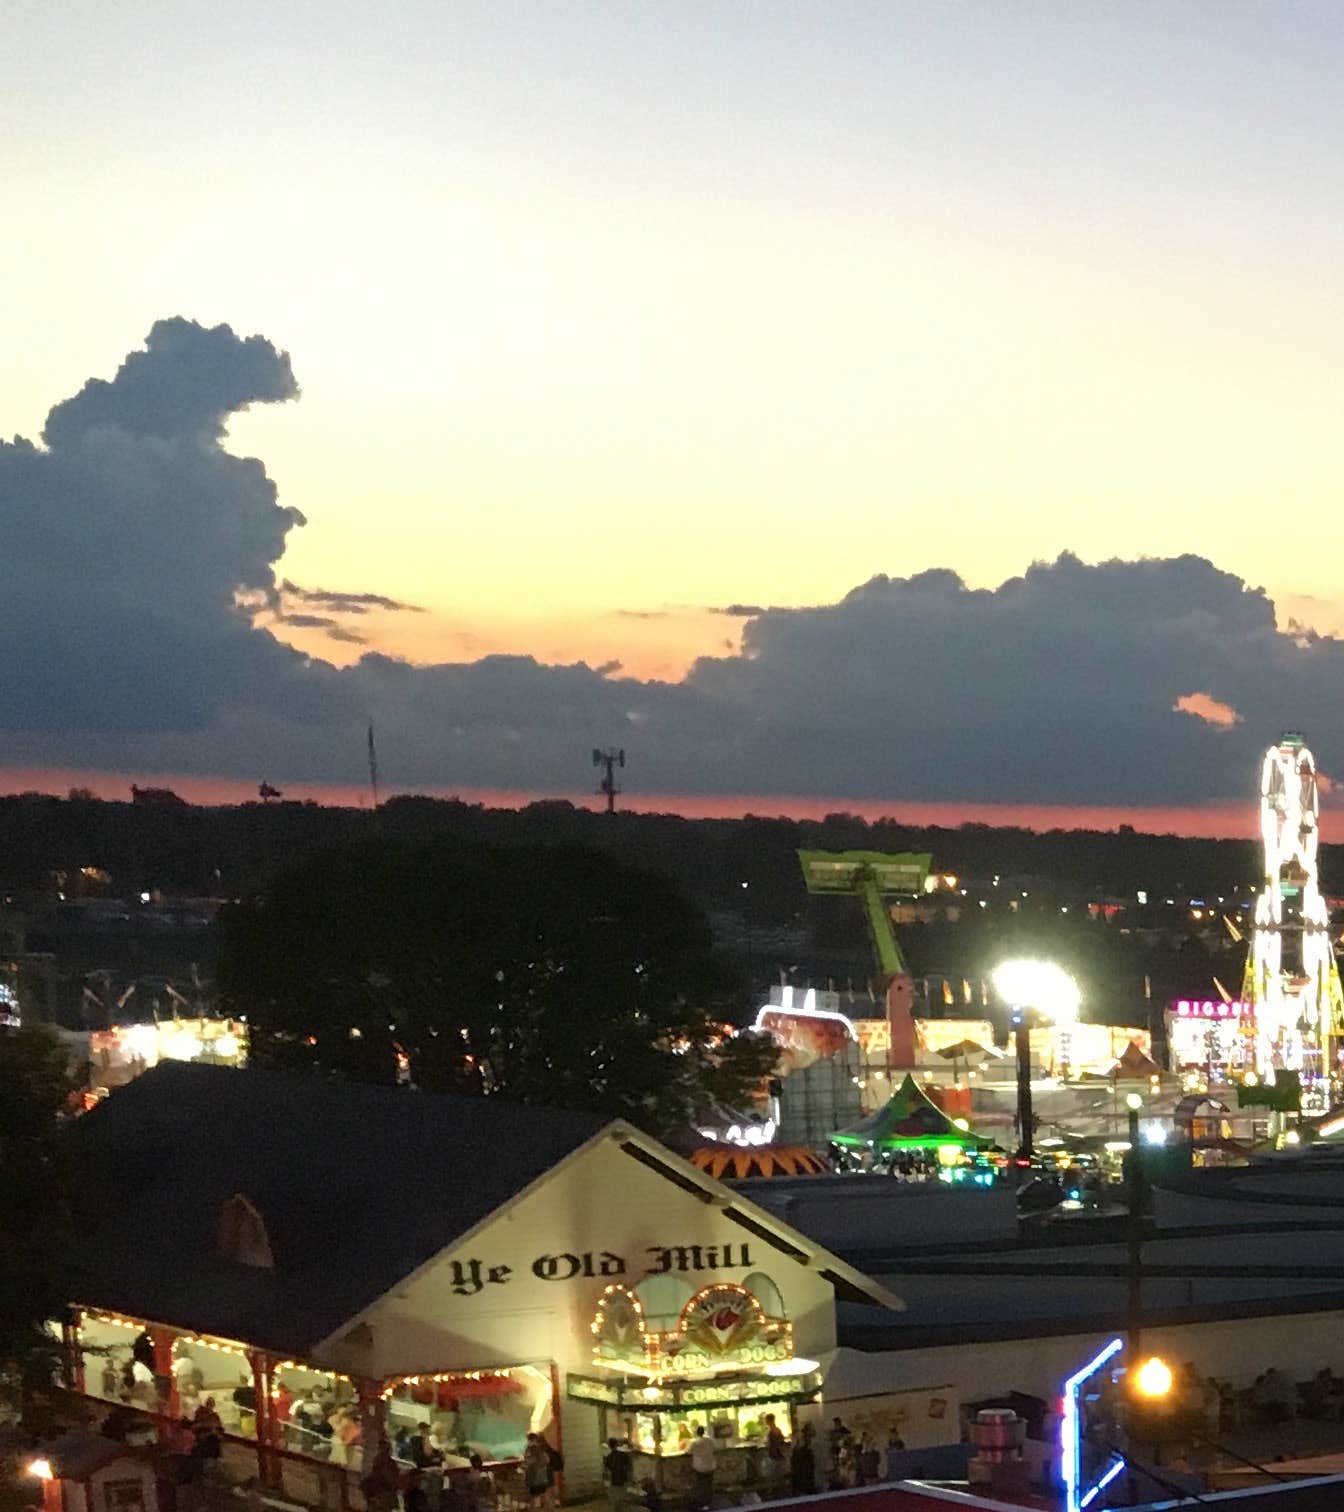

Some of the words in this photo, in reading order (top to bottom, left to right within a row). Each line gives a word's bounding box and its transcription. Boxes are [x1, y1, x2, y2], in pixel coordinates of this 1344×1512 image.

[450, 1258, 512, 1295] Ye
[532, 1252, 626, 1280] Old
[645, 1243, 756, 1274] Mill
[661, 1354, 711, 1371] CORN
[739, 1345, 787, 1364] DOGS
[683, 1387, 730, 1402] CORN
[756, 1379, 801, 1396] DOGS
